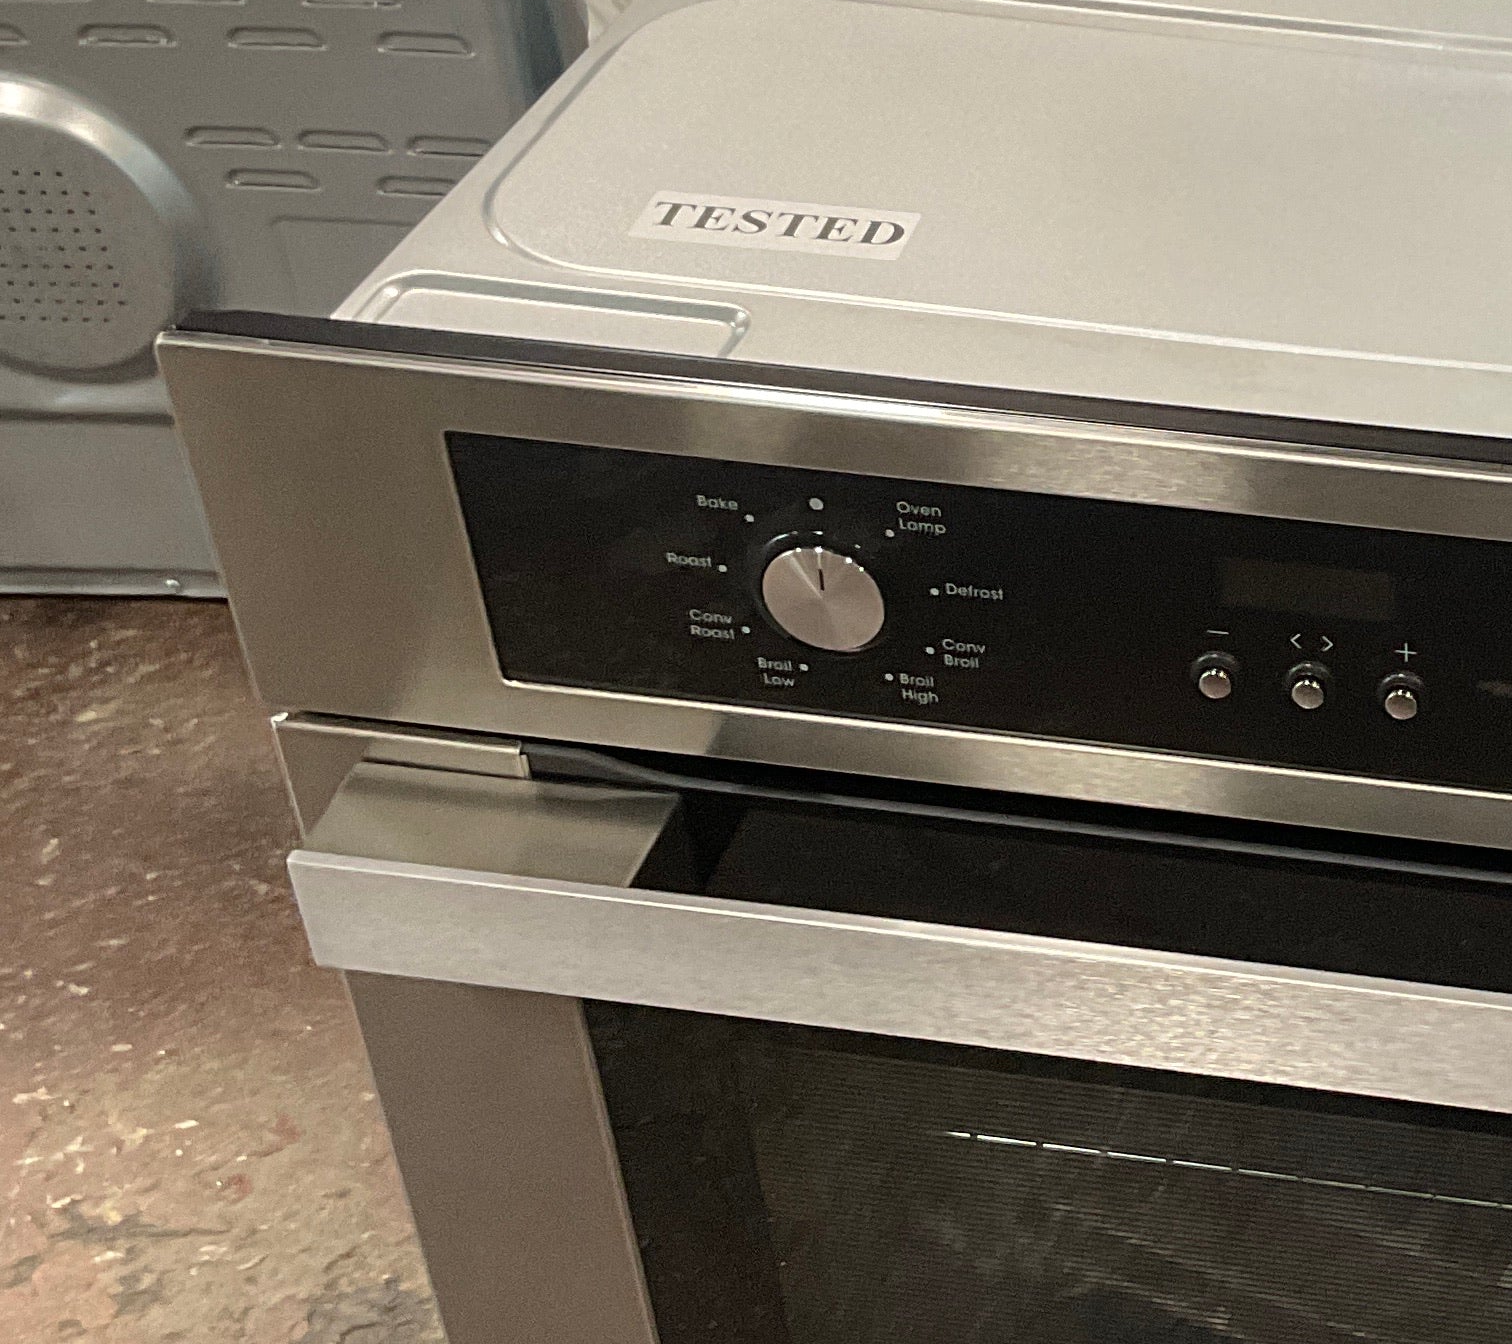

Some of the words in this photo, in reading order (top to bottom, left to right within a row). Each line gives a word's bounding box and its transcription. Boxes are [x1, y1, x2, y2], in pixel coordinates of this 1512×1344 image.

[655, 201, 905, 245] TESTED
[696, 495, 738, 510] Bake
[896, 501, 942, 517] Oven
[898, 517, 946, 535] Lamp
[666, 553, 712, 567] Roast
[945, 583, 1004, 600] Defrost
[689, 609, 732, 624] Conv
[690, 626, 735, 640] Roast
[942, 639, 986, 654] Conv
[757, 657, 793, 671] Broil
[944, 654, 980, 669] Broil
[764, 673, 795, 687] Low
[899, 673, 934, 687] Broil
[901, 688, 939, 704] High
